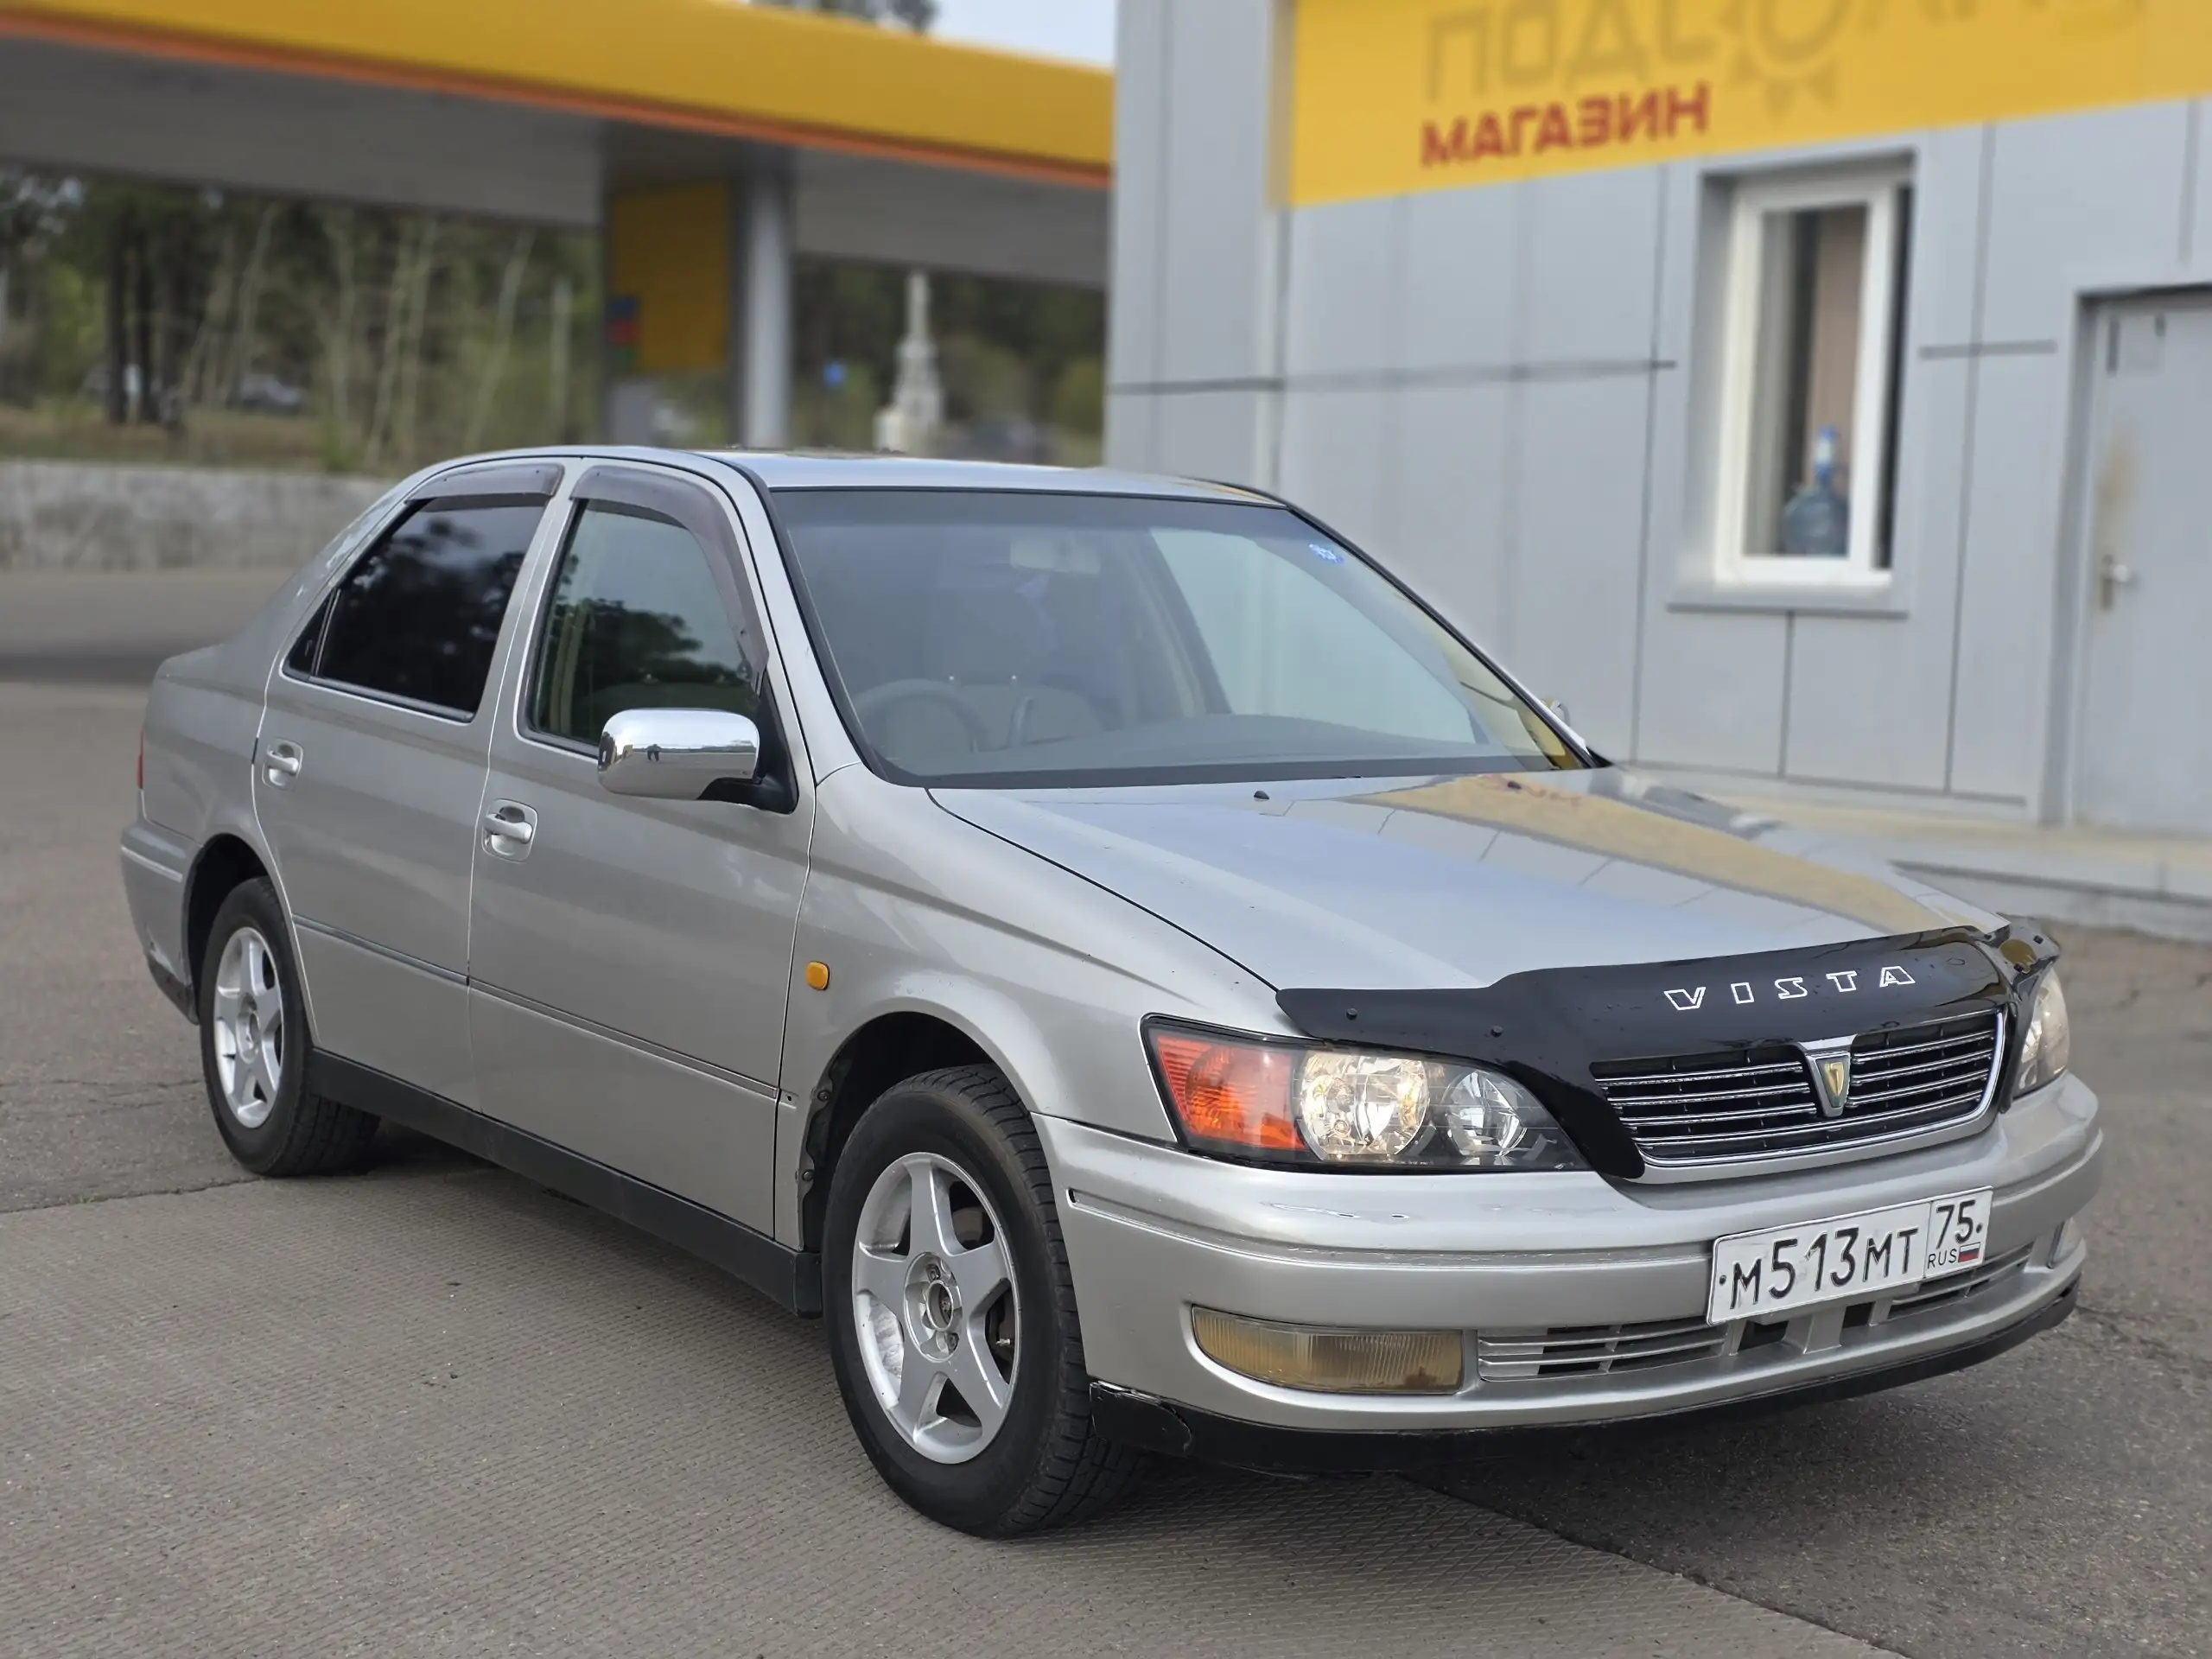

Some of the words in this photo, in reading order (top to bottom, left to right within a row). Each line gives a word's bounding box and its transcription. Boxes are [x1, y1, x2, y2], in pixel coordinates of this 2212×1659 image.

[1421, 83, 1711, 166] МАГАЗИН
[1663, 965, 1916, 1011] VISTA
[1935, 1199, 1977, 1249] 75
[1927, 1249, 1957, 1269] RUS
